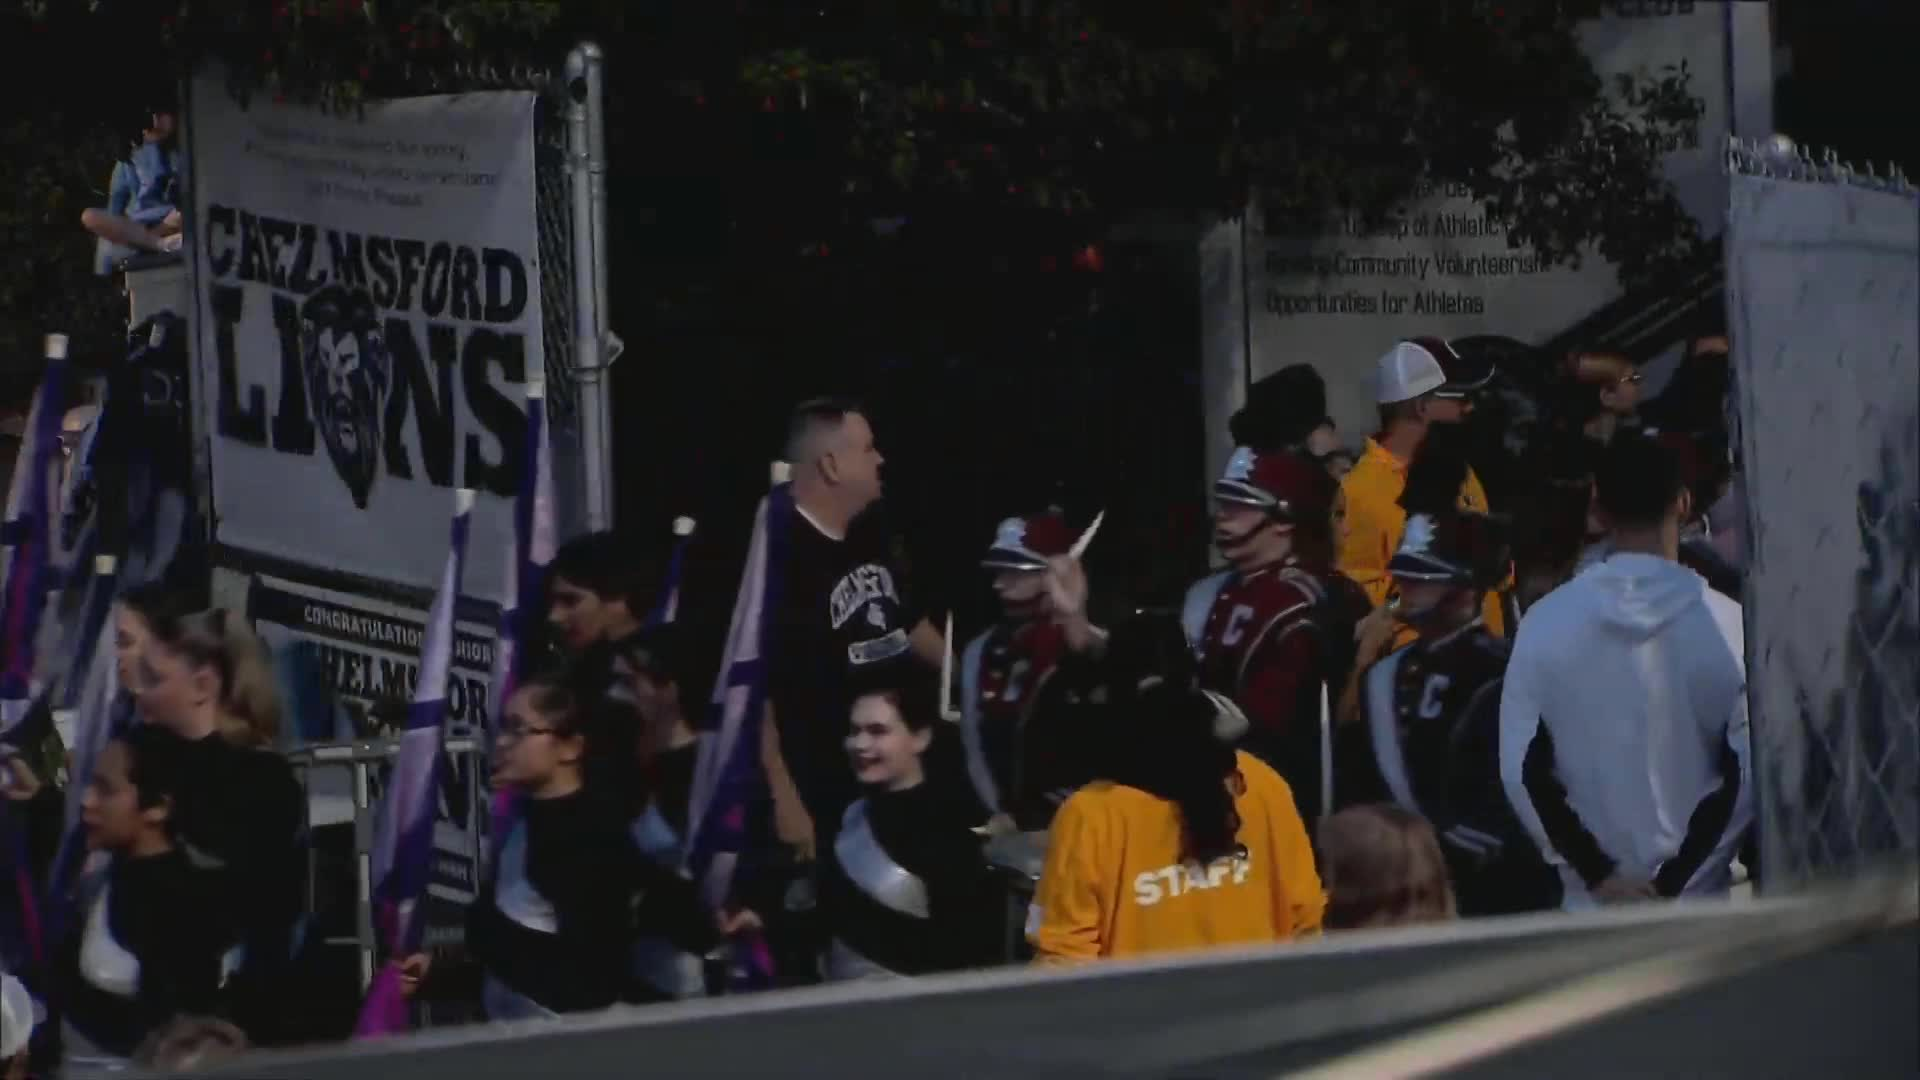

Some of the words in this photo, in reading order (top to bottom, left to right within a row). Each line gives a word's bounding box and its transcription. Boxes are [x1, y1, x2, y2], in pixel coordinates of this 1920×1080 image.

[206, 204, 528, 322] CHELMSFORD
[1335, 252, 1429, 280] Community
[1265, 291, 1377, 315] Opportunities
[1382, 291, 1409, 314] for
[1221, 604, 1254, 646] C
[1420, 673, 1451, 719] C
[1133, 855, 1252, 906] STAFF
